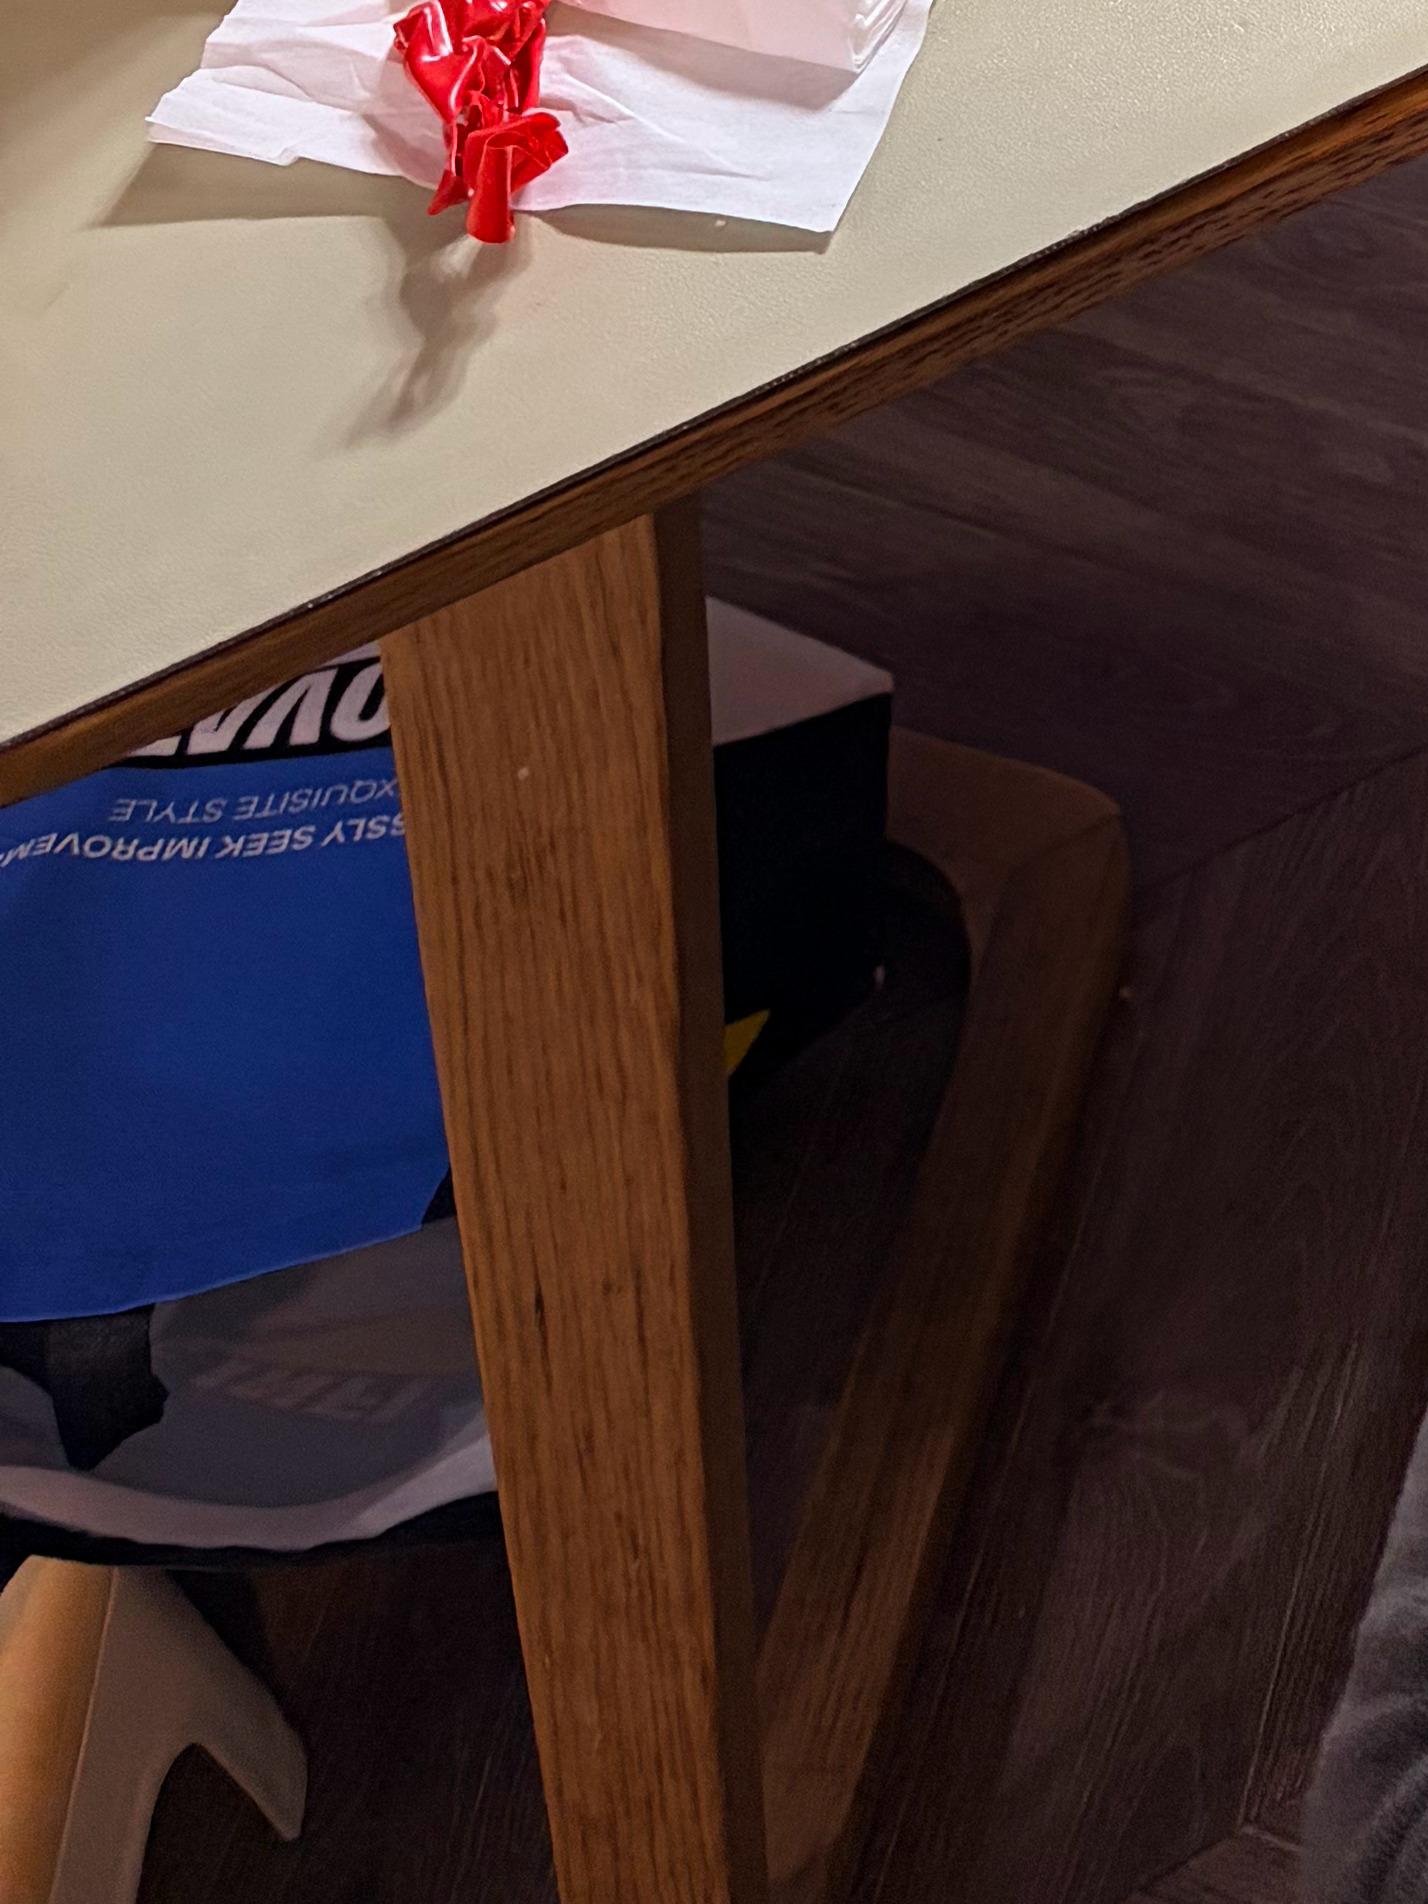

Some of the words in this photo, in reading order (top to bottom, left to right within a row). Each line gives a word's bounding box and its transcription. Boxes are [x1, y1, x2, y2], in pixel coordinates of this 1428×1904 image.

[106, 797, 229, 824] STYLE
[0, 832, 211, 869] IMPROVEM
[214, 825, 317, 860] SEEK
